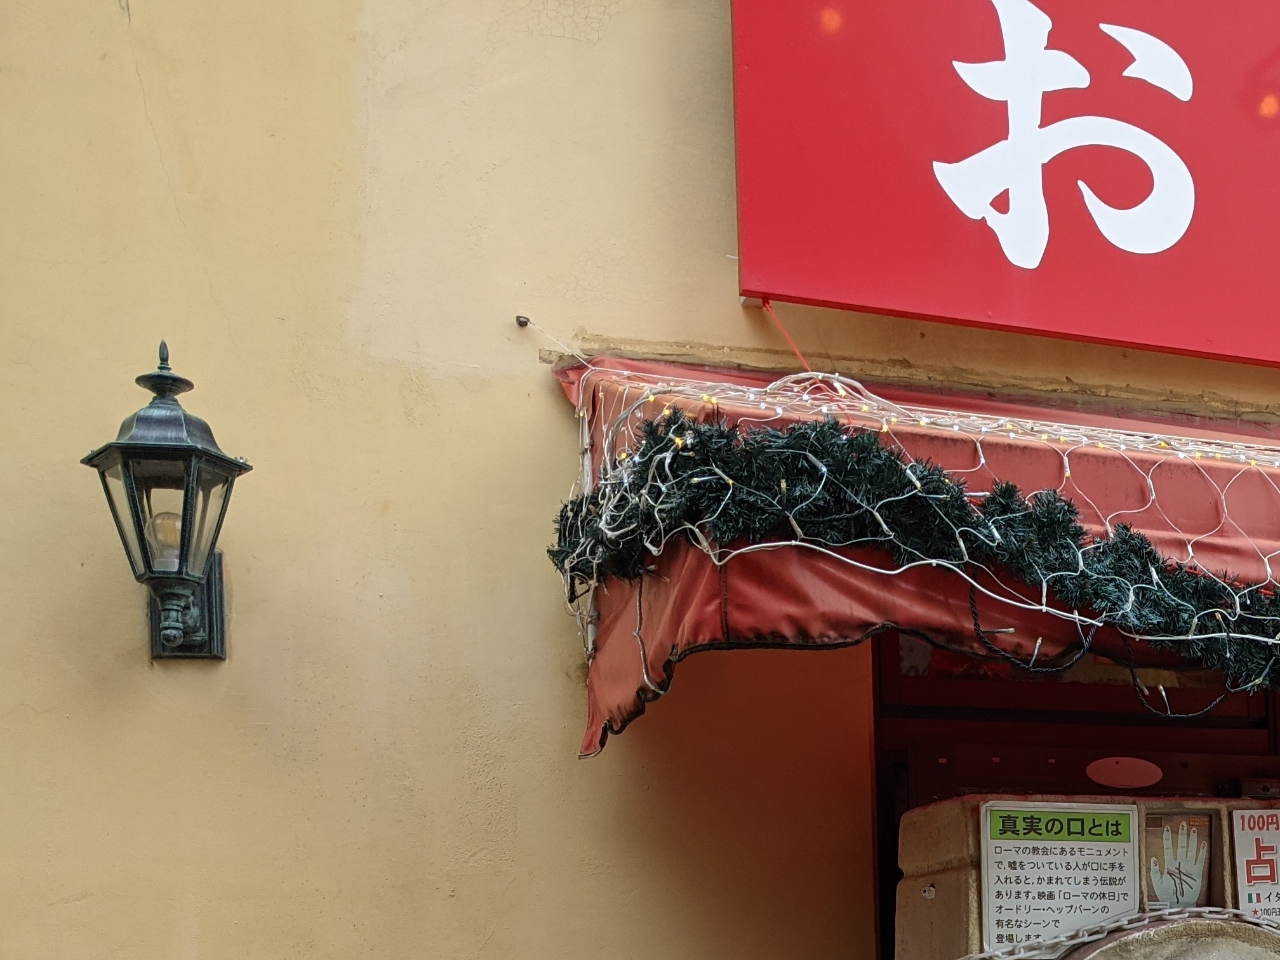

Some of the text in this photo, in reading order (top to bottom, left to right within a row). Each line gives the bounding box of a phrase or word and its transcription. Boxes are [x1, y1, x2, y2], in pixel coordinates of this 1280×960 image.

[998, 814, 1123, 837] 真実の口とは
[994, 845, 1129, 857] ローマの教会にあるモニュメント
[994, 889, 1129, 902] あります。映画「ローマの休日」で
[995, 904, 1110, 915] オードリー・ヘップバーンの
[995, 918, 1061, 929] 有名なシーンで
